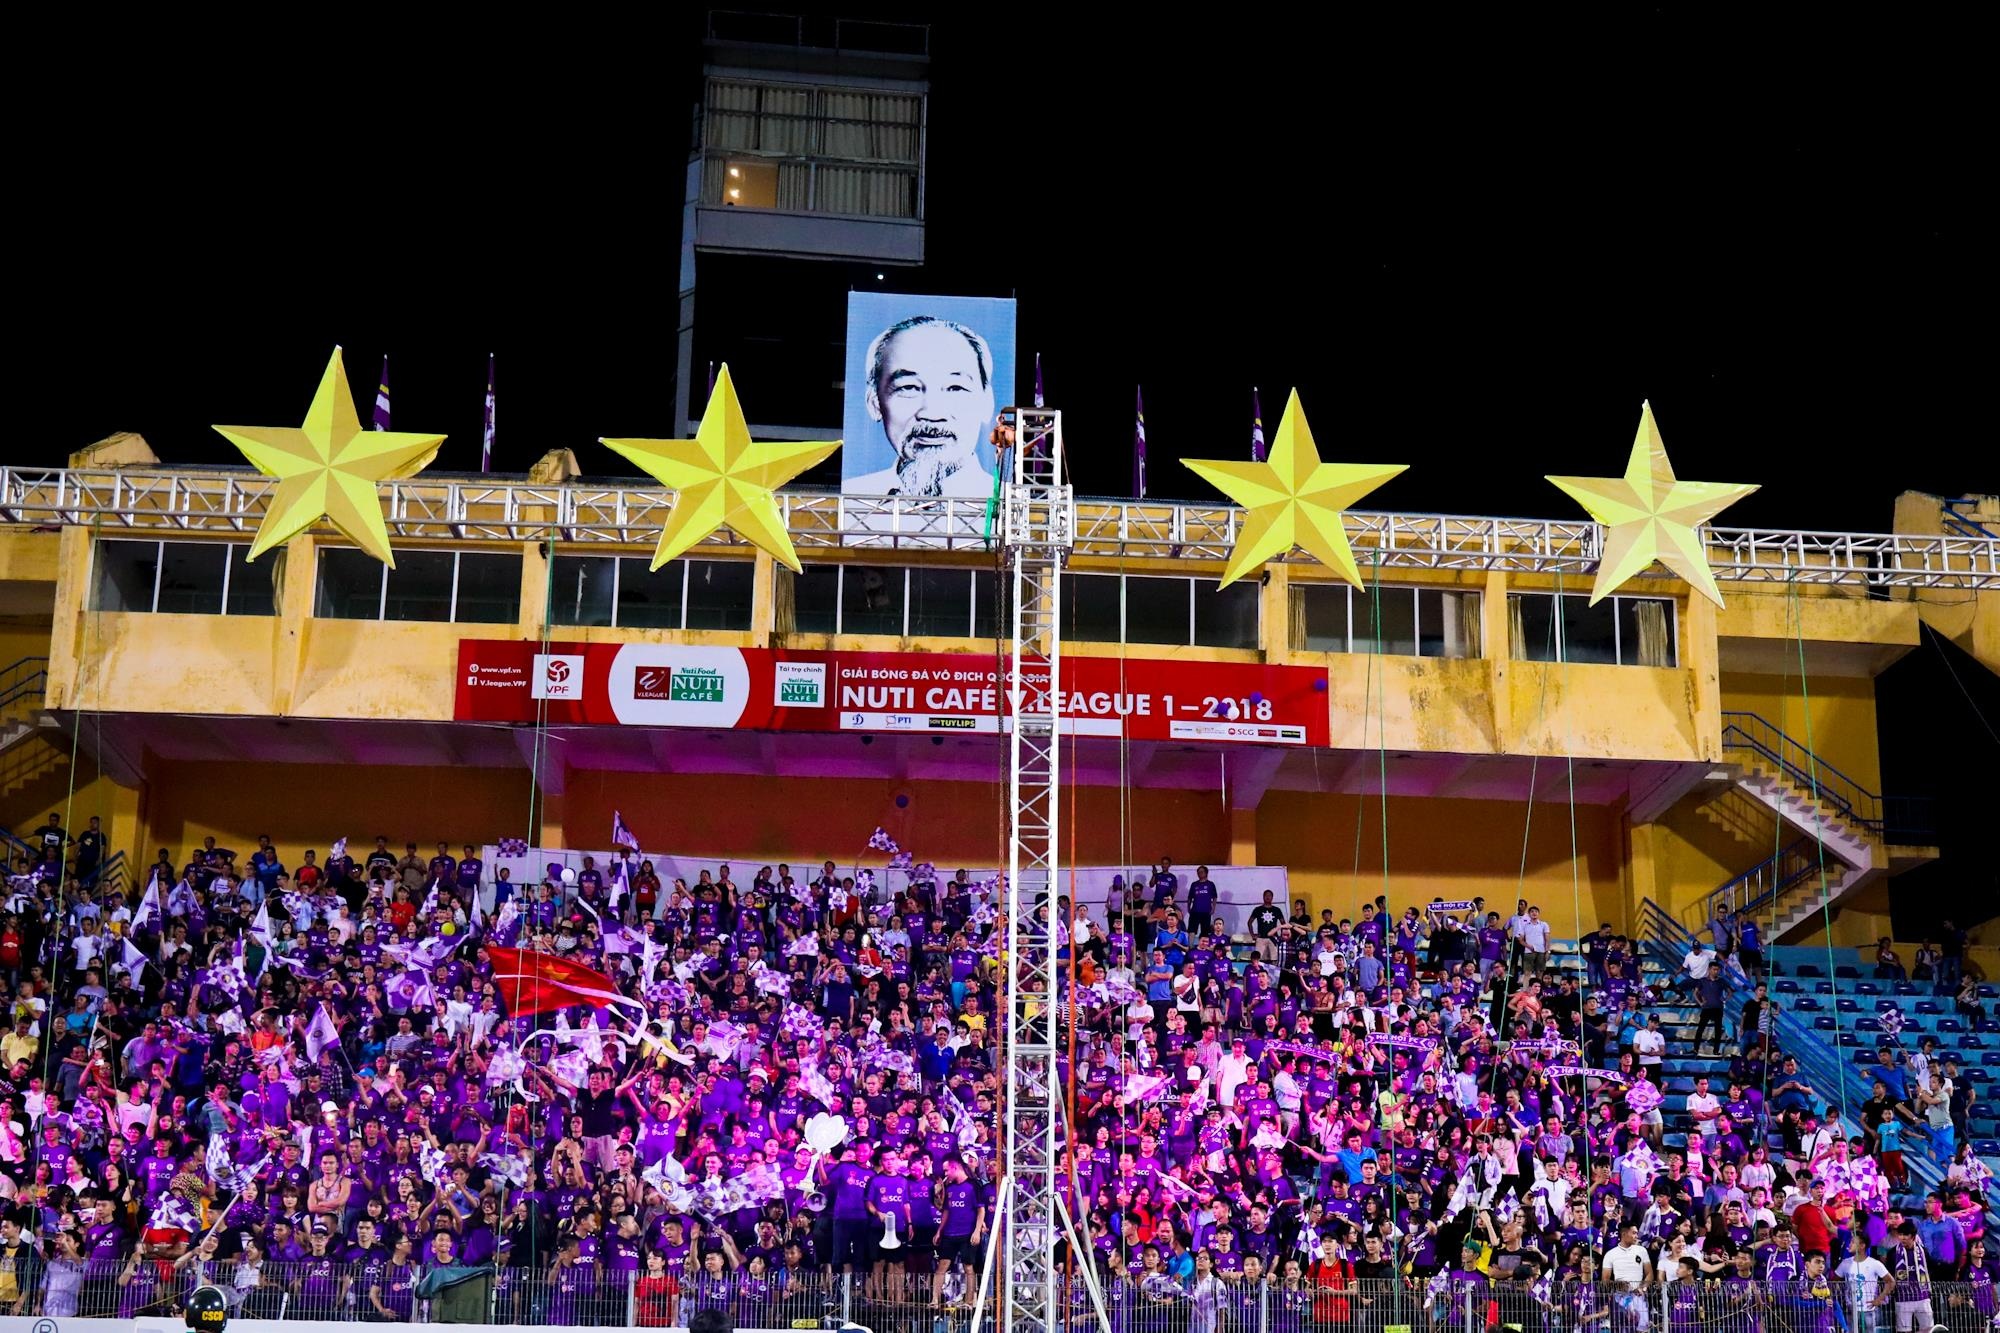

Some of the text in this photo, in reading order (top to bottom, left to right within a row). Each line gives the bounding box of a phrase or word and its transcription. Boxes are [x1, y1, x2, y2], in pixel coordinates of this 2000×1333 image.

[871, 668, 908, 680] BÓNG
[911, 669, 930, 680] ĐÁ
[932, 668, 950, 680] VÔ
[954, 671, 984, 683] ĐỊCH
[673, 676, 722, 691] NUTI
[546, 686, 569, 694] VPF
[782, 684, 818, 694] NUTI
[681, 691, 713, 700] CAFÉ
[842, 685, 914, 709] NUTI
[925, 683, 997, 711] CAFÉ
[897, 716, 912, 724] PTI
[941, 719, 975, 727] TUYLIPS
[1237, 728, 1254, 736] SCG
[889, 1195, 902, 1203] SCG
